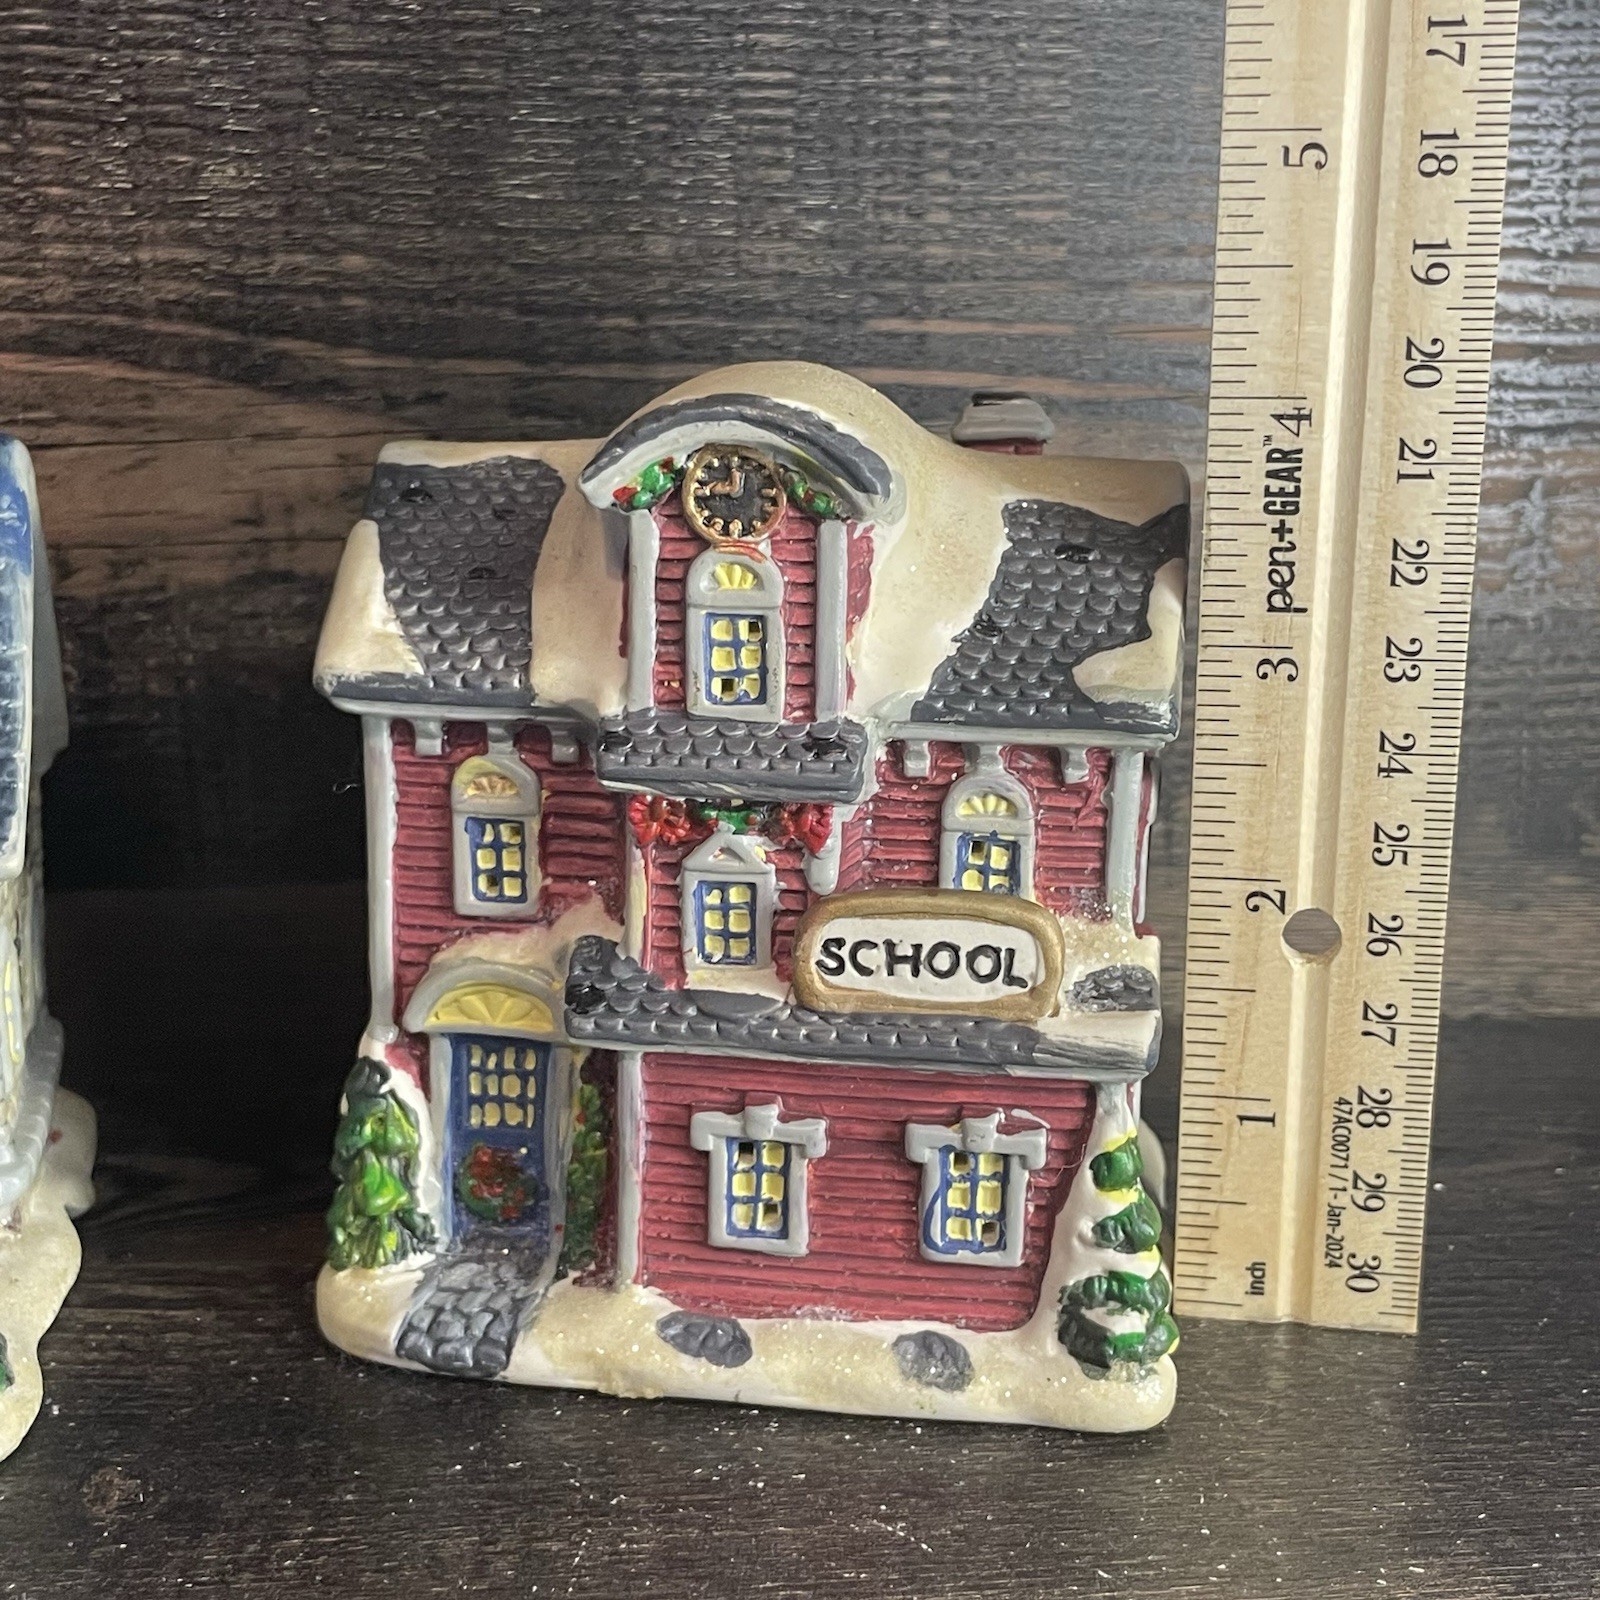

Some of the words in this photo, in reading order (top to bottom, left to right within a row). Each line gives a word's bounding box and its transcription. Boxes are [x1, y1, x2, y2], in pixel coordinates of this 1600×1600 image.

[1426, 14, 1468, 67] 17
[1281, 142, 1328, 170] 5
[1418, 128, 1460, 178] 18
[1411, 238, 1452, 286] 19
[1404, 336, 1445, 388] 20
[1270, 406, 1313, 437] 4
[1397, 437, 1437, 484] 21
[1390, 538, 1430, 587] 22
[1256, 657, 1299, 682] 3
[1383, 636, 1423, 683] 23
[1377, 730, 1416, 778] 24
[1371, 821, 1410, 866] 25
[1245, 888, 1286, 915] 2
[1365, 912, 1404, 957] 26
[815, 937, 1028, 989] SCHOOL
[1361, 1000, 1398, 1046] 27
[1236, 1111, 1276, 1128] 1
[1355, 1085, 1393, 1129] 28
[1331, 1096, 1353, 1169] 47AC0071
[1351, 1170, 1387, 1212] 29
[1244, 1261, 1266, 1296] inch
[1345, 1252, 1381, 1293] 30
